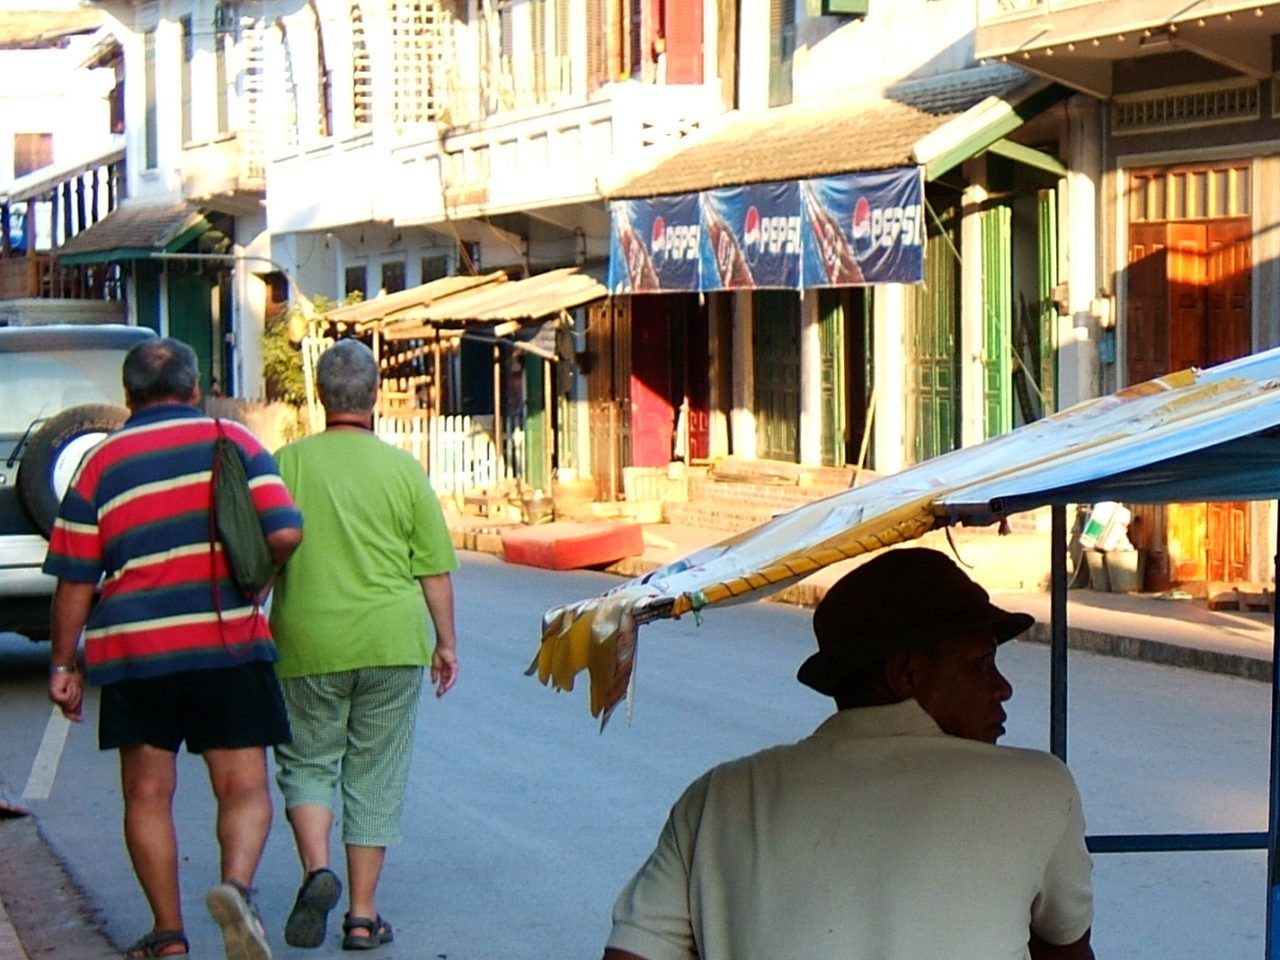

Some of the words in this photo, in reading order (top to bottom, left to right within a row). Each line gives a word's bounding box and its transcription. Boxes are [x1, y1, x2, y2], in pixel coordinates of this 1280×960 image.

[665, 224, 700, 260] PEPSI
[760, 217, 800, 254] PEPSI
[871, 205, 922, 246] PEPSI
